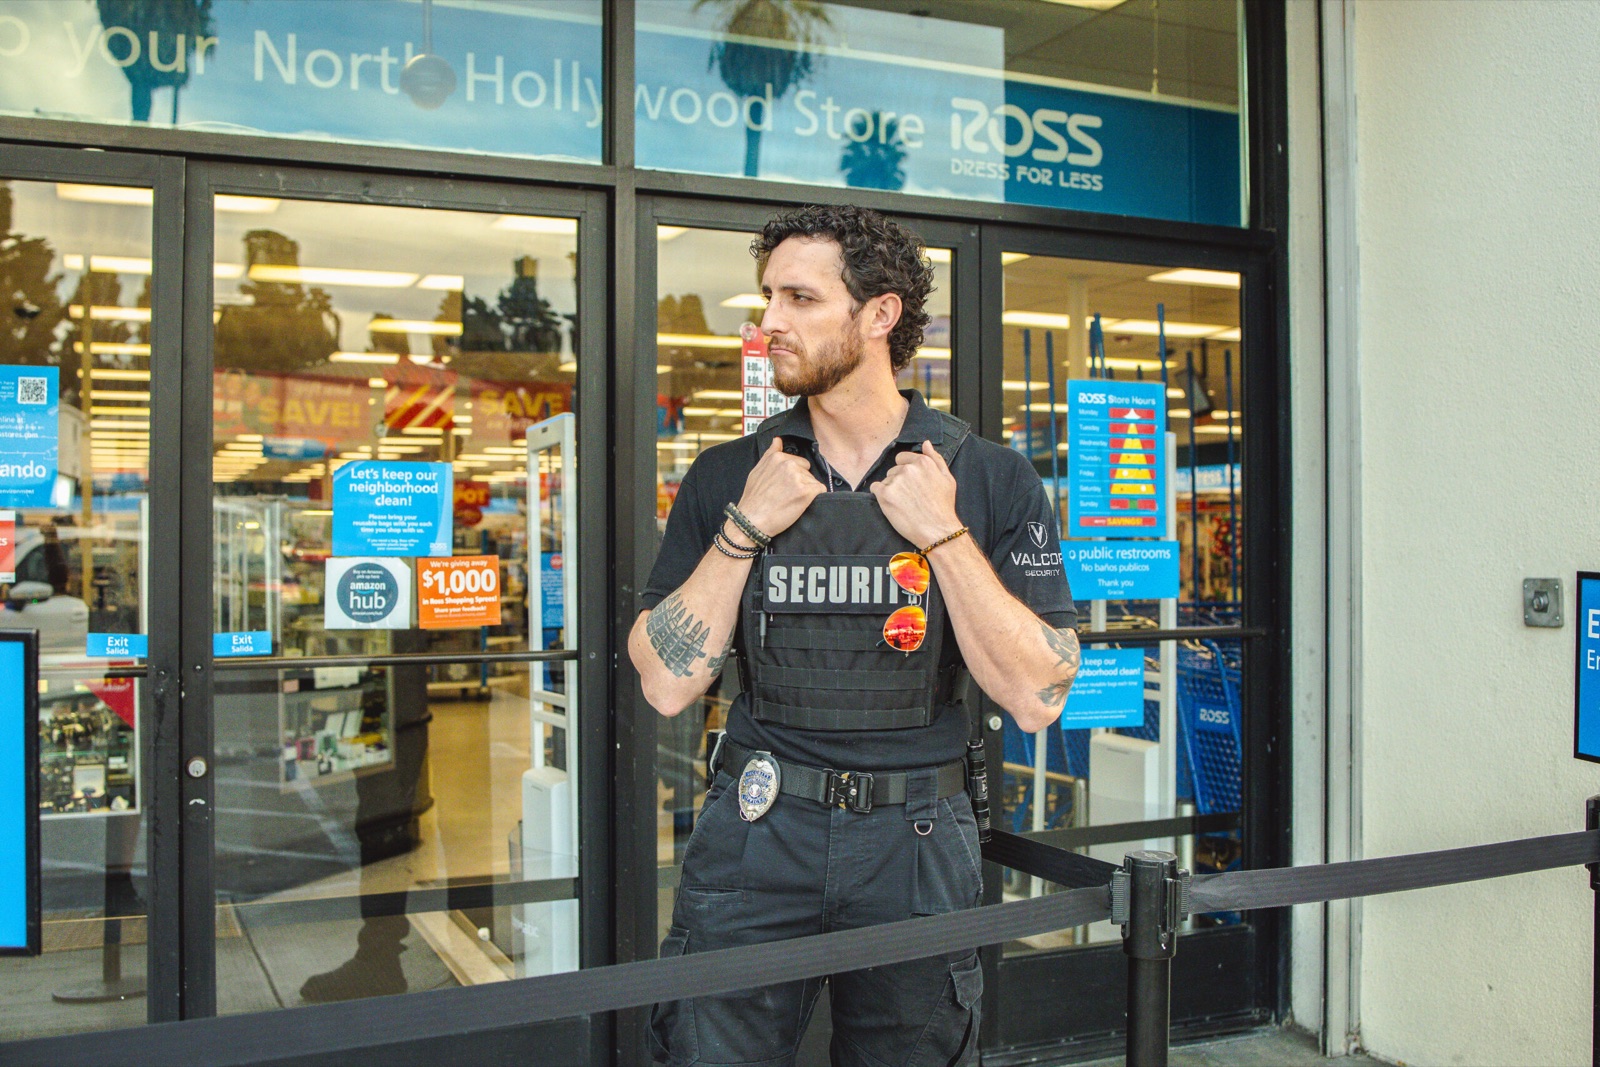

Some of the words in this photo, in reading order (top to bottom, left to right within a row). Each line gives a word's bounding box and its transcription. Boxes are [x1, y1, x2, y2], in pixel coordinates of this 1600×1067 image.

[63, 21, 219, 79] your
[253, 30, 413, 95] Nort
[793, 89, 925, 149] Store
[951, 97, 1103, 167] ROSS
[951, 158, 1010, 180] DRESS
[1016, 165, 1053, 186] FOR
[1058, 169, 1103, 191] LESS
[1078, 392, 1107, 404] ROSS
[1108, 395, 1130, 404] Store
[1131, 396, 1156, 406] Hours
[382, 468, 413, 483] keep
[416, 471, 438, 481] our
[349, 481, 439, 495] neighborhood
[375, 494, 413, 506] clean!
[1079, 547, 1114, 562] public
[1116, 548, 1171, 560] restrooms
[430, 560, 449, 568] We're
[450, 560, 470, 569] giving
[1081, 563, 1093, 572] No
[1094, 563, 1117, 572] baños
[1025, 569, 1060, 577] SECURITY
[350, 582, 386, 590] amazon
[422, 568, 496, 596] $1,000
[768, 565, 918, 605] SECURIT
[1097, 578, 1119, 587] Thank
[1121, 580, 1134, 588] you
[350, 591, 386, 609] hub
[445, 596, 474, 605] Shopping
[107, 636, 129, 647] Exit
[232, 635, 253, 645] Exit
[105, 647, 129, 655] Salida
[231, 645, 254, 653] Salida
[1084, 657, 1103, 667] keep
[1119, 667, 1141, 676] clean!
[1200, 708, 1230, 725] ROSS
